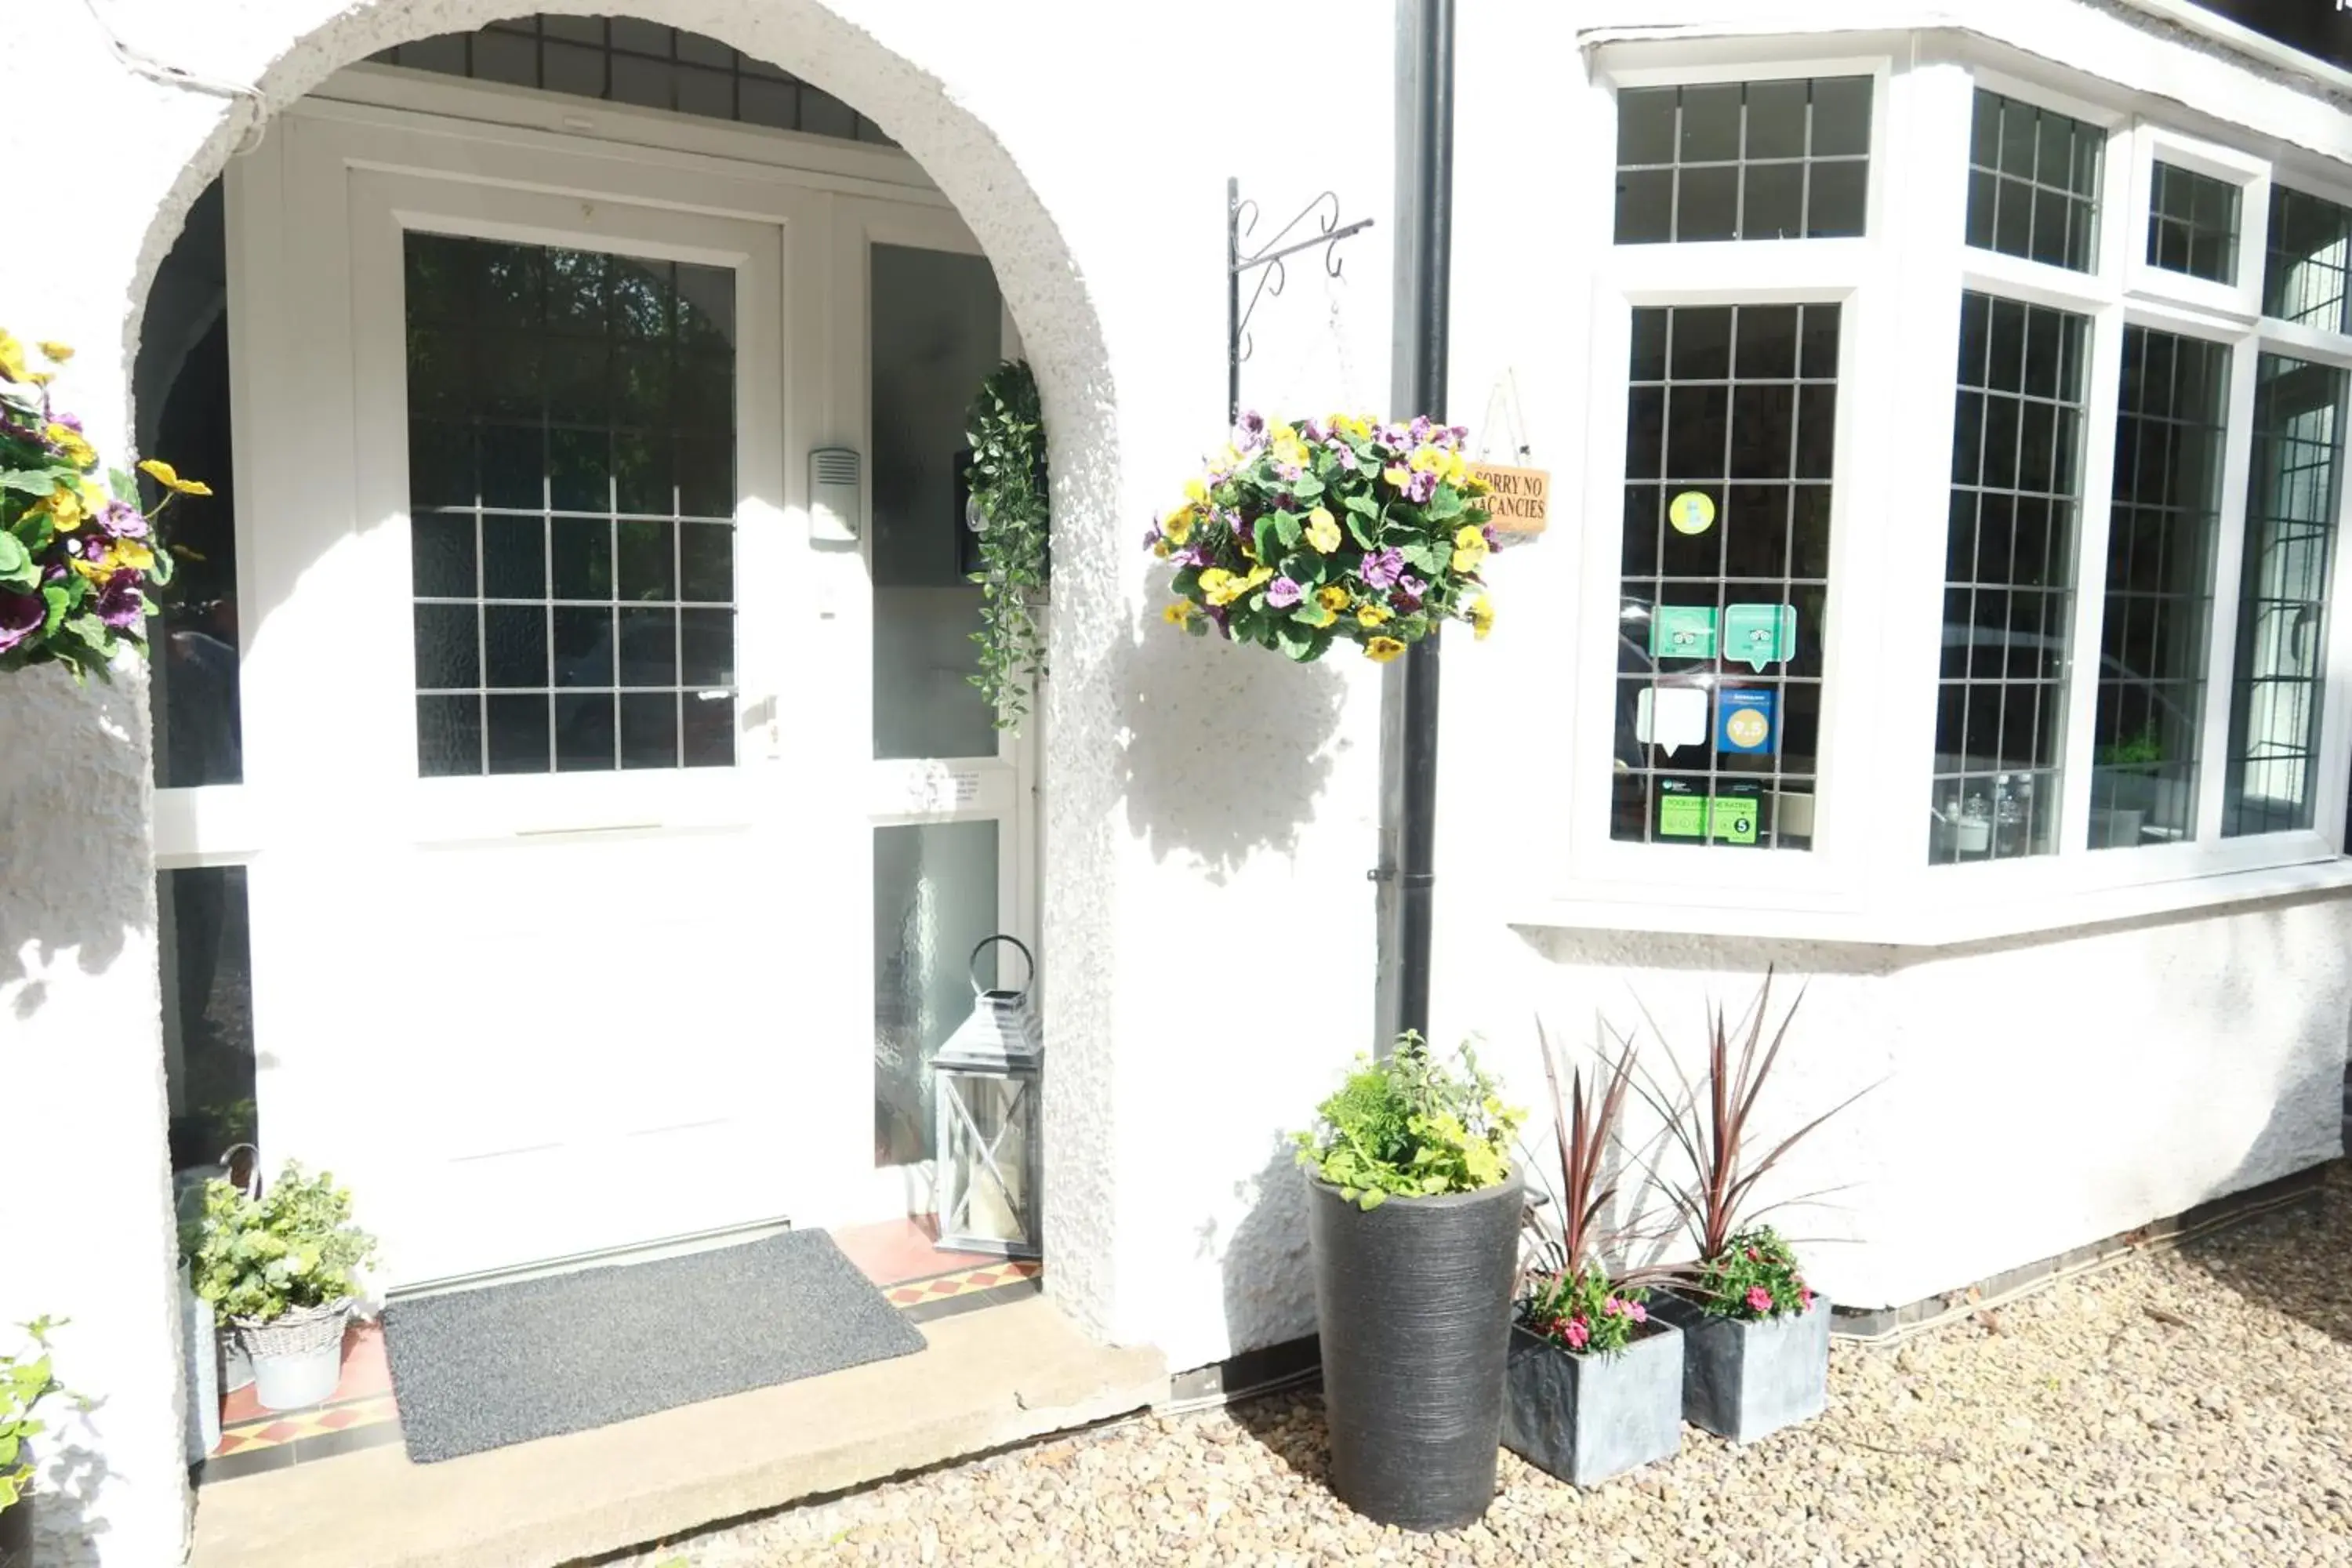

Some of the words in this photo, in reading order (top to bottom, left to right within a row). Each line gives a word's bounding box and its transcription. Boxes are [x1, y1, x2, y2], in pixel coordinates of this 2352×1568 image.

[1523, 476, 1542, 497] NO
[1733, 720, 1762, 736] 9.5
[1737, 819, 1747, 832] 5
